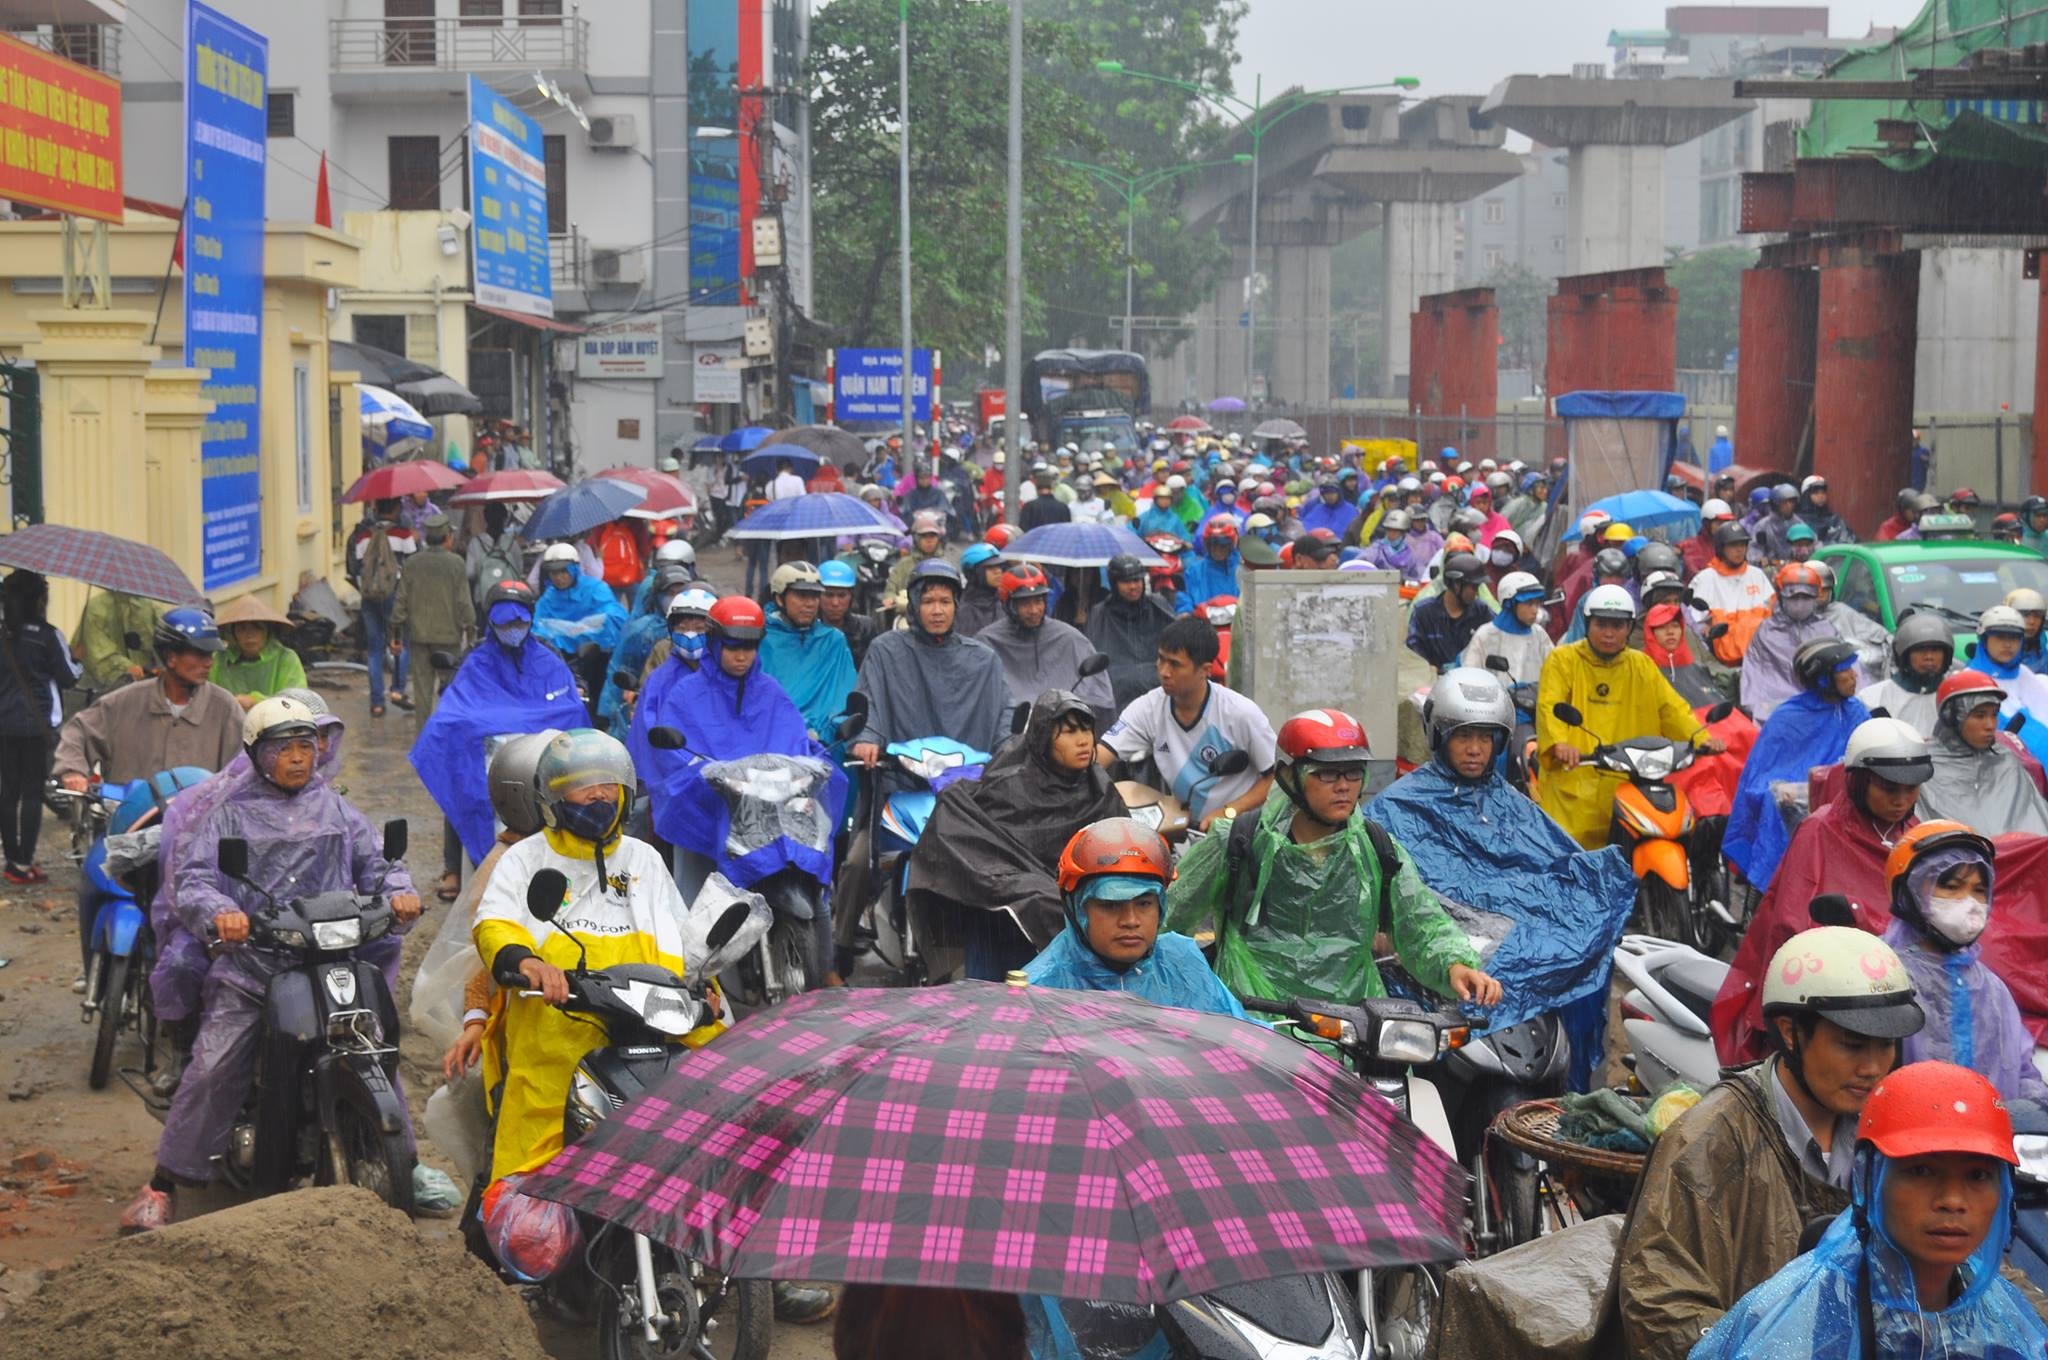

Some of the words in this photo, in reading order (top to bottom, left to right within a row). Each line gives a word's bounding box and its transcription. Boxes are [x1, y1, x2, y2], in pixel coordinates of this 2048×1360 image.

[840, 372, 865, 398] QUẬN
[867, 375, 889, 396] NAM
[628, 1046, 662, 1055] HONDA
